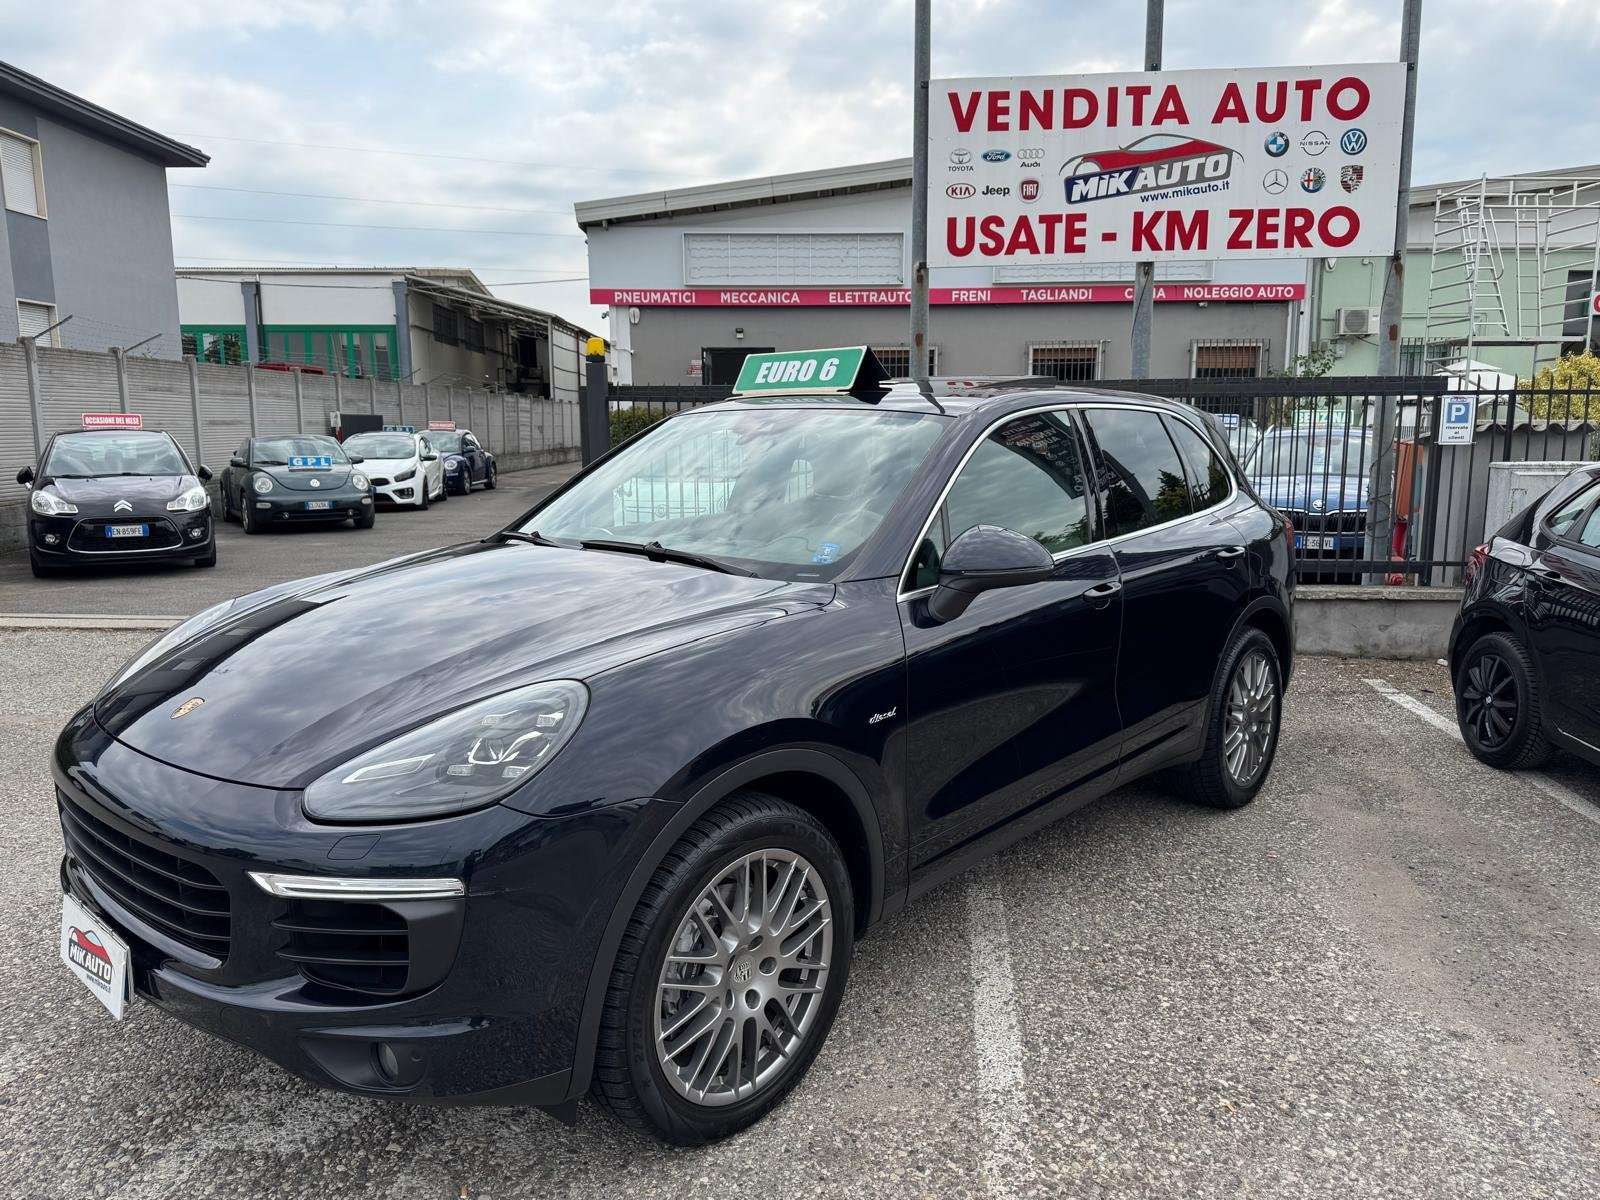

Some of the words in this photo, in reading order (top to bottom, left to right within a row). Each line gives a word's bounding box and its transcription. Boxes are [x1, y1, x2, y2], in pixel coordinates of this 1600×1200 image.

[948, 84, 1190, 132] VENDITA
[1211, 77, 1370, 124] AUTO
[951, 186, 971, 196] KIA
[982, 185, 1010, 197] Jeep
[1022, 184, 1039, 197] FIAT
[1140, 181, 1230, 203] www.mikauto.it
[947, 213, 1087, 257] USATE
[1131, 210, 1209, 252] KM
[1227, 205, 1360, 250] ZERO
[614, 292, 696, 303] PNEUMATICI
[720, 292, 800, 303] MECCANICA
[829, 291, 911, 303] ELETTRAUTO
[952, 290, 991, 302] FRENI
[1020, 288, 1092, 300] TAGLIANDI
[1183, 286, 1254, 299] NOLEGGIO
[1257, 286, 1294, 298] AUTO
[754, 358, 817, 384] EURO
[818, 357, 840, 381] 6
[1451, 404, 1466, 422] P
[85, 416, 115, 425] OCCASIONE
[116, 416, 125, 425] DEL
